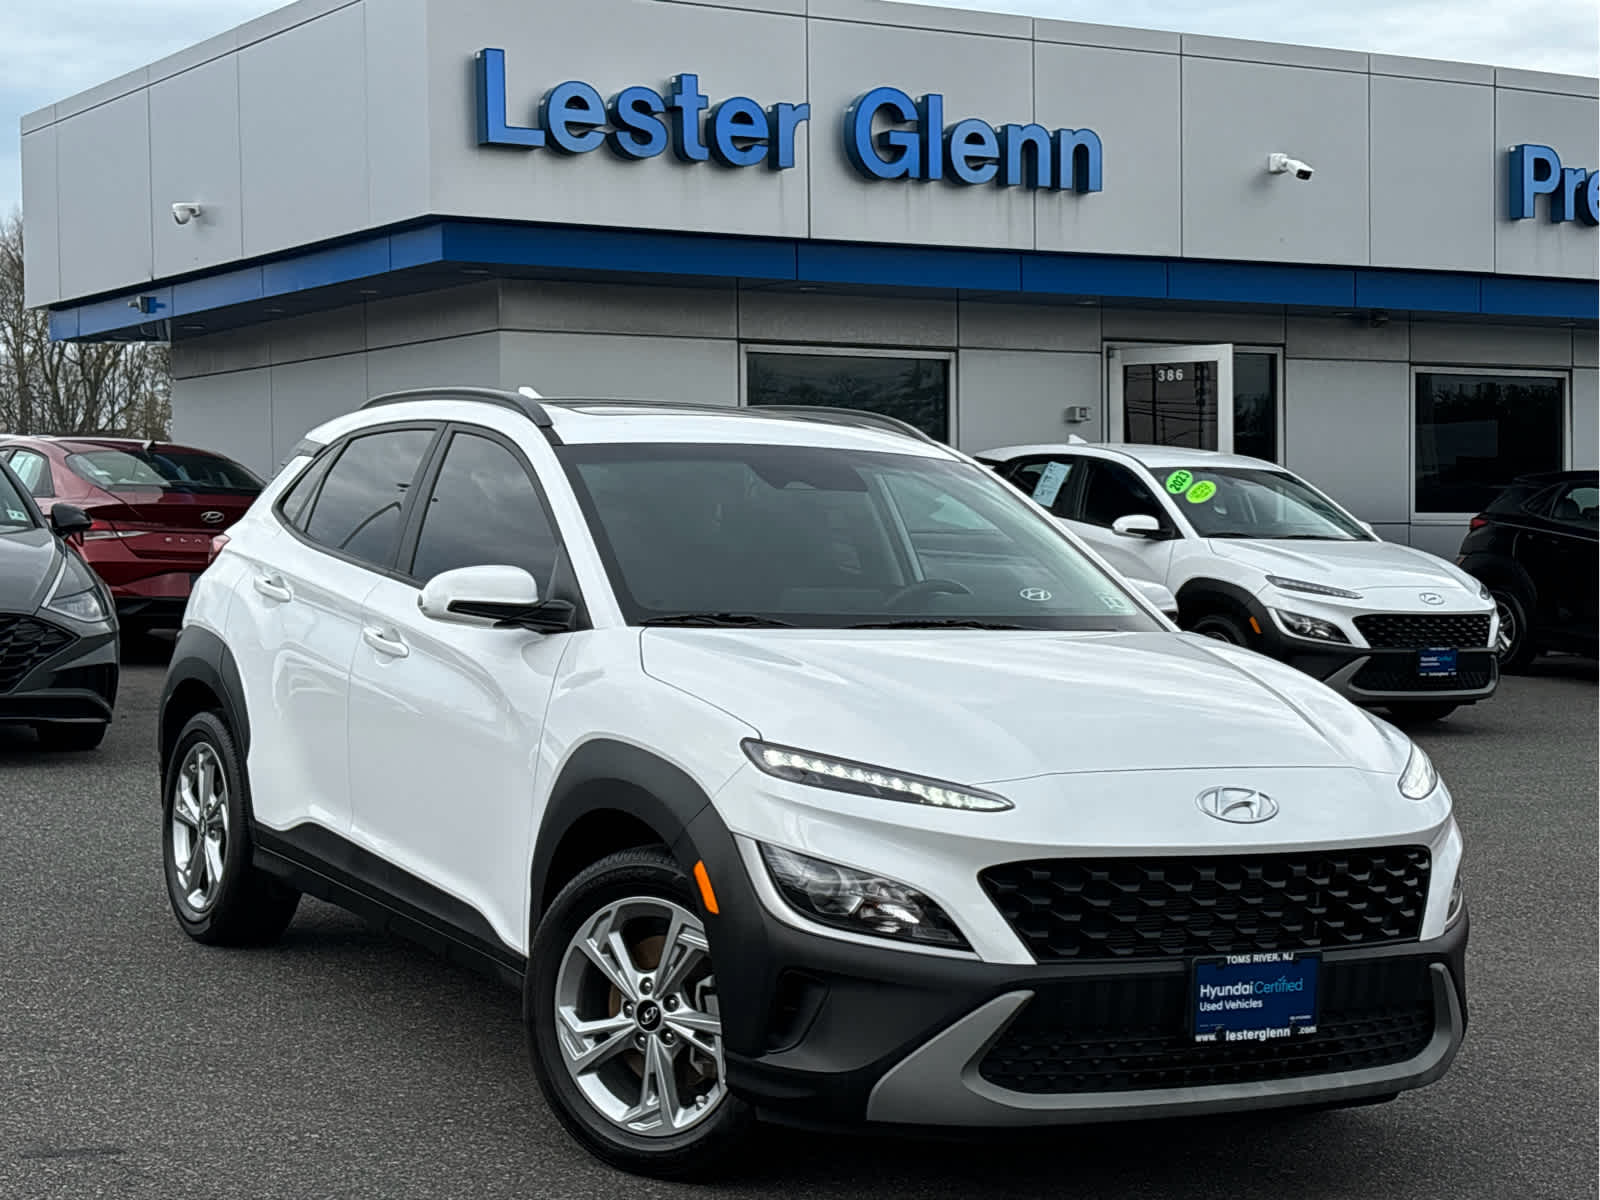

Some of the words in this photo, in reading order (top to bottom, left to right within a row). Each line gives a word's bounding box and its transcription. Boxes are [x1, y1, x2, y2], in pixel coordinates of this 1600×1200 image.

[477, 47, 810, 169] Lester
[846, 87, 1102, 192] Glenn
[1158, 369, 1184, 382] 386
[1169, 471, 1190, 492] 2023
[1226, 954, 1250, 965] TOMS
[1283, 952, 1294, 961] NJ
[1200, 981, 1253, 999] Hyundai
[1254, 976, 1303, 994] Certified
[1200, 1001, 1223, 1012] Used
[1224, 999, 1263, 1010] Vehicles
[1225, 1027, 1291, 1042] lesterglenn
